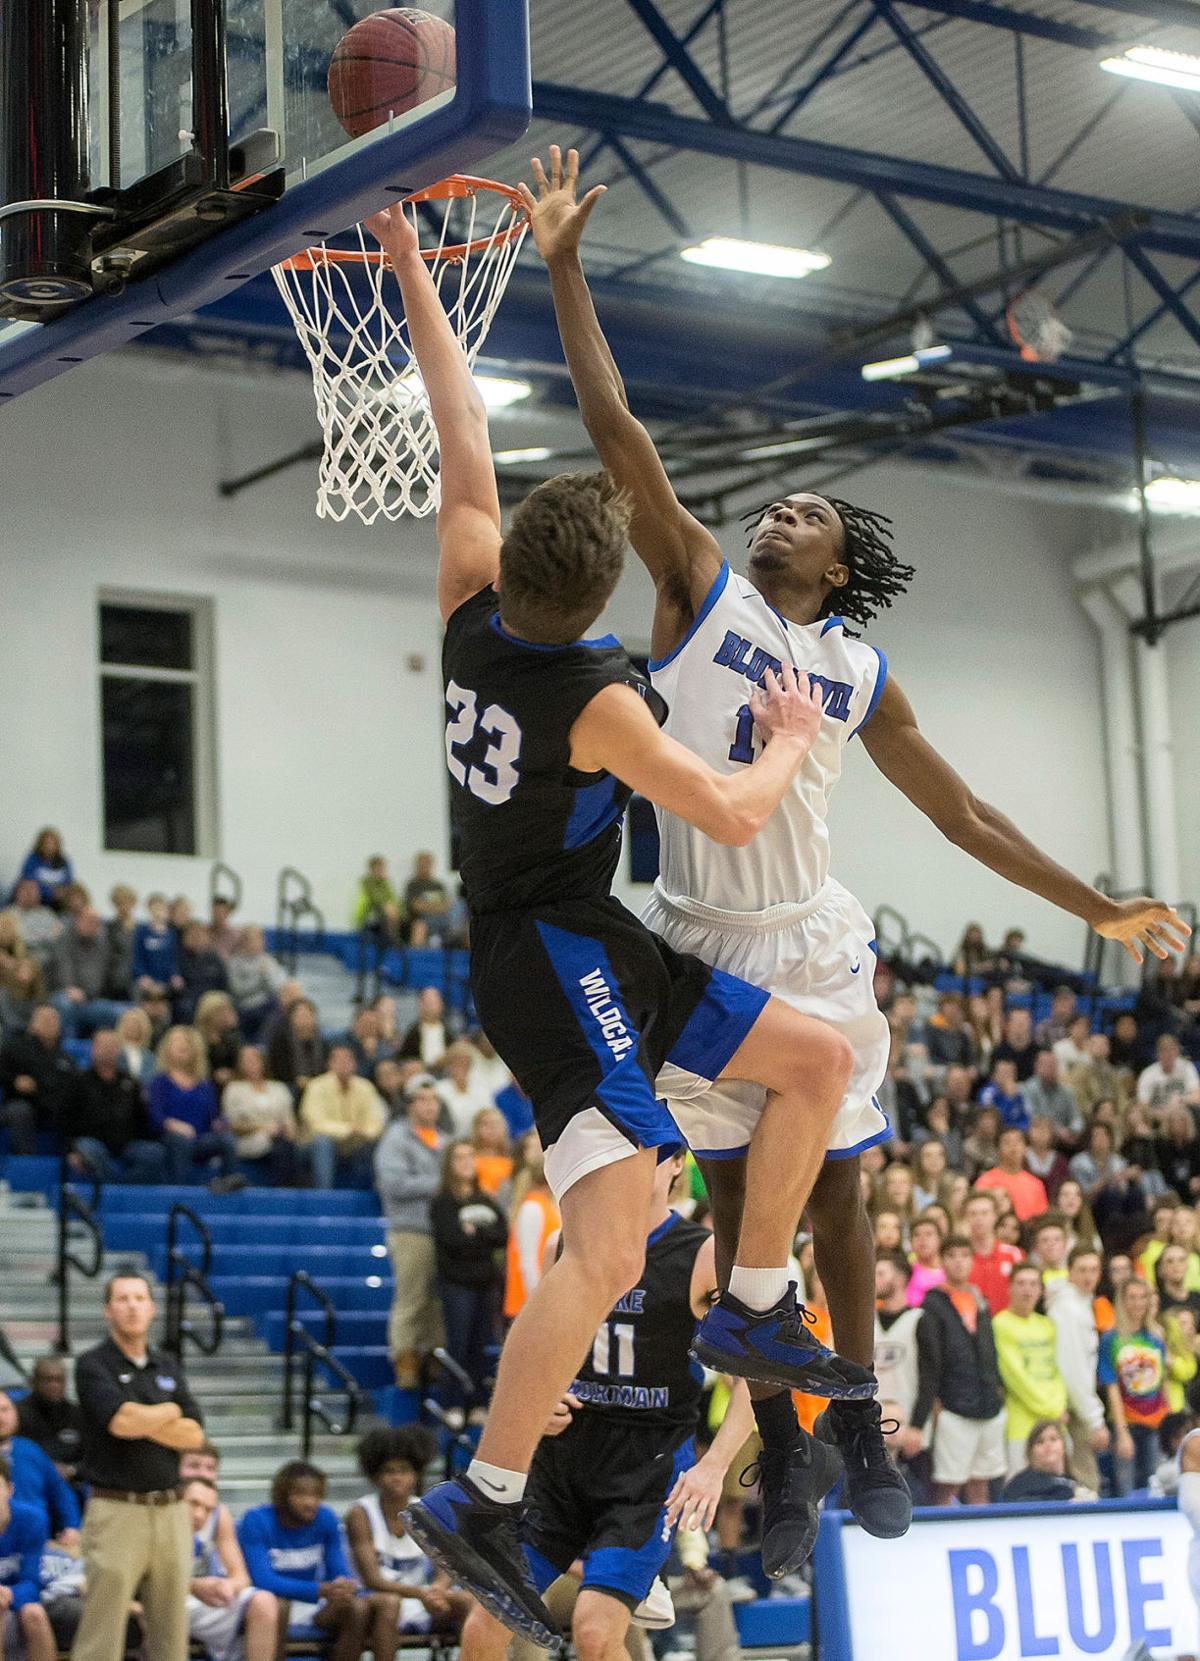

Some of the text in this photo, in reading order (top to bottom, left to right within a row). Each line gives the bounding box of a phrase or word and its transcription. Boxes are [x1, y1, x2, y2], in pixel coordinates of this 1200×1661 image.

[445, 679, 522, 805] 23
[728, 703, 767, 764] 1
[592, 1322, 635, 1376] 11
[947, 1537, 1173, 1661] BLUE
